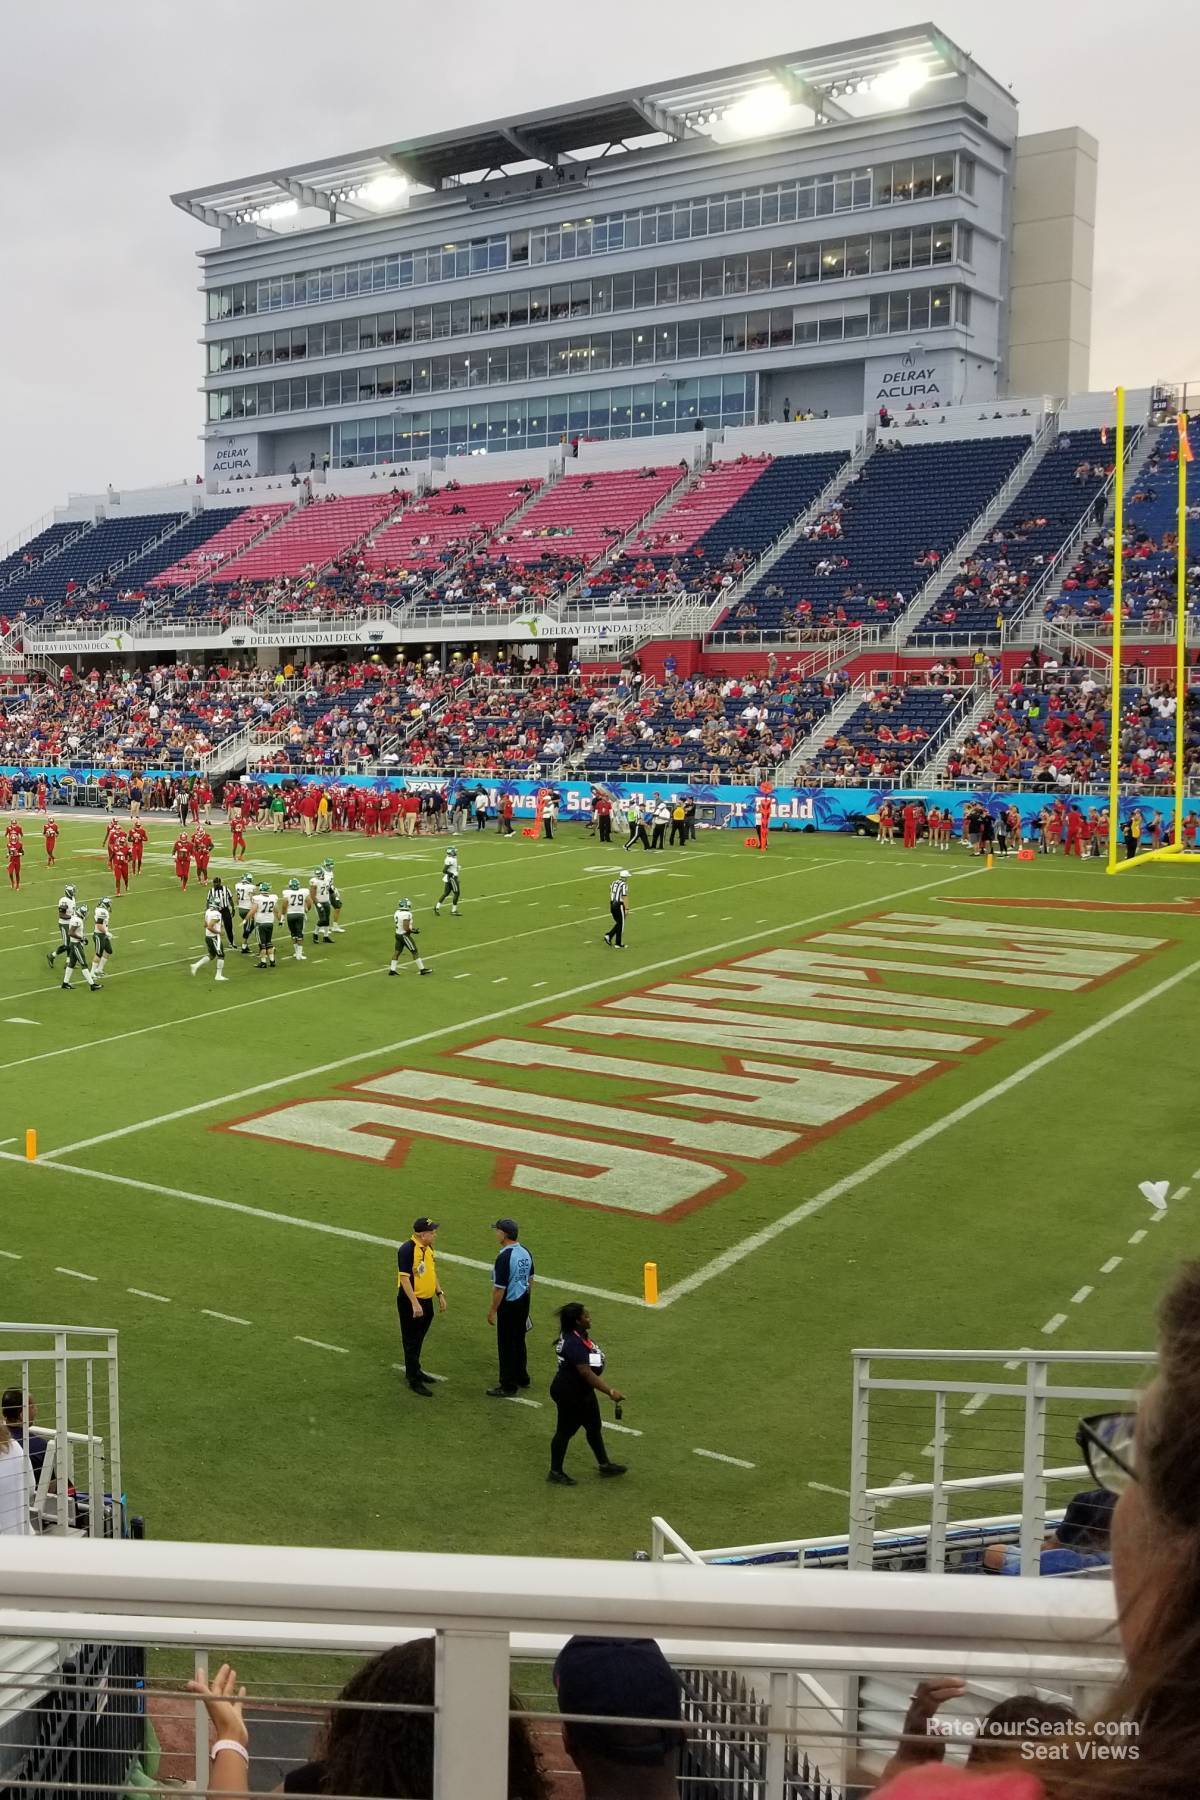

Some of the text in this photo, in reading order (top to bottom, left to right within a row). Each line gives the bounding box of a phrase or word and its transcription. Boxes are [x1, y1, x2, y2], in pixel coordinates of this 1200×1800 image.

[882, 368, 936, 383] DELRAY
[876, 383, 940, 400] ACURA
[216, 448, 248, 459] DELRAY
[212, 460, 251, 471] ACURA
[542, 626, 581, 636] DELRAY
[250, 635, 287, 645] DELRAY
[288, 634, 334, 644] HYUNDAI
[335, 633, 362, 642] DECK
[33, 644, 58, 652] DELRAY
[59, 643, 90, 651] HYUNDAI
[290, 894, 304, 907] 79
[262, 901, 275, 914] 72
[214, 908, 1180, 1221] ATLANTIC
